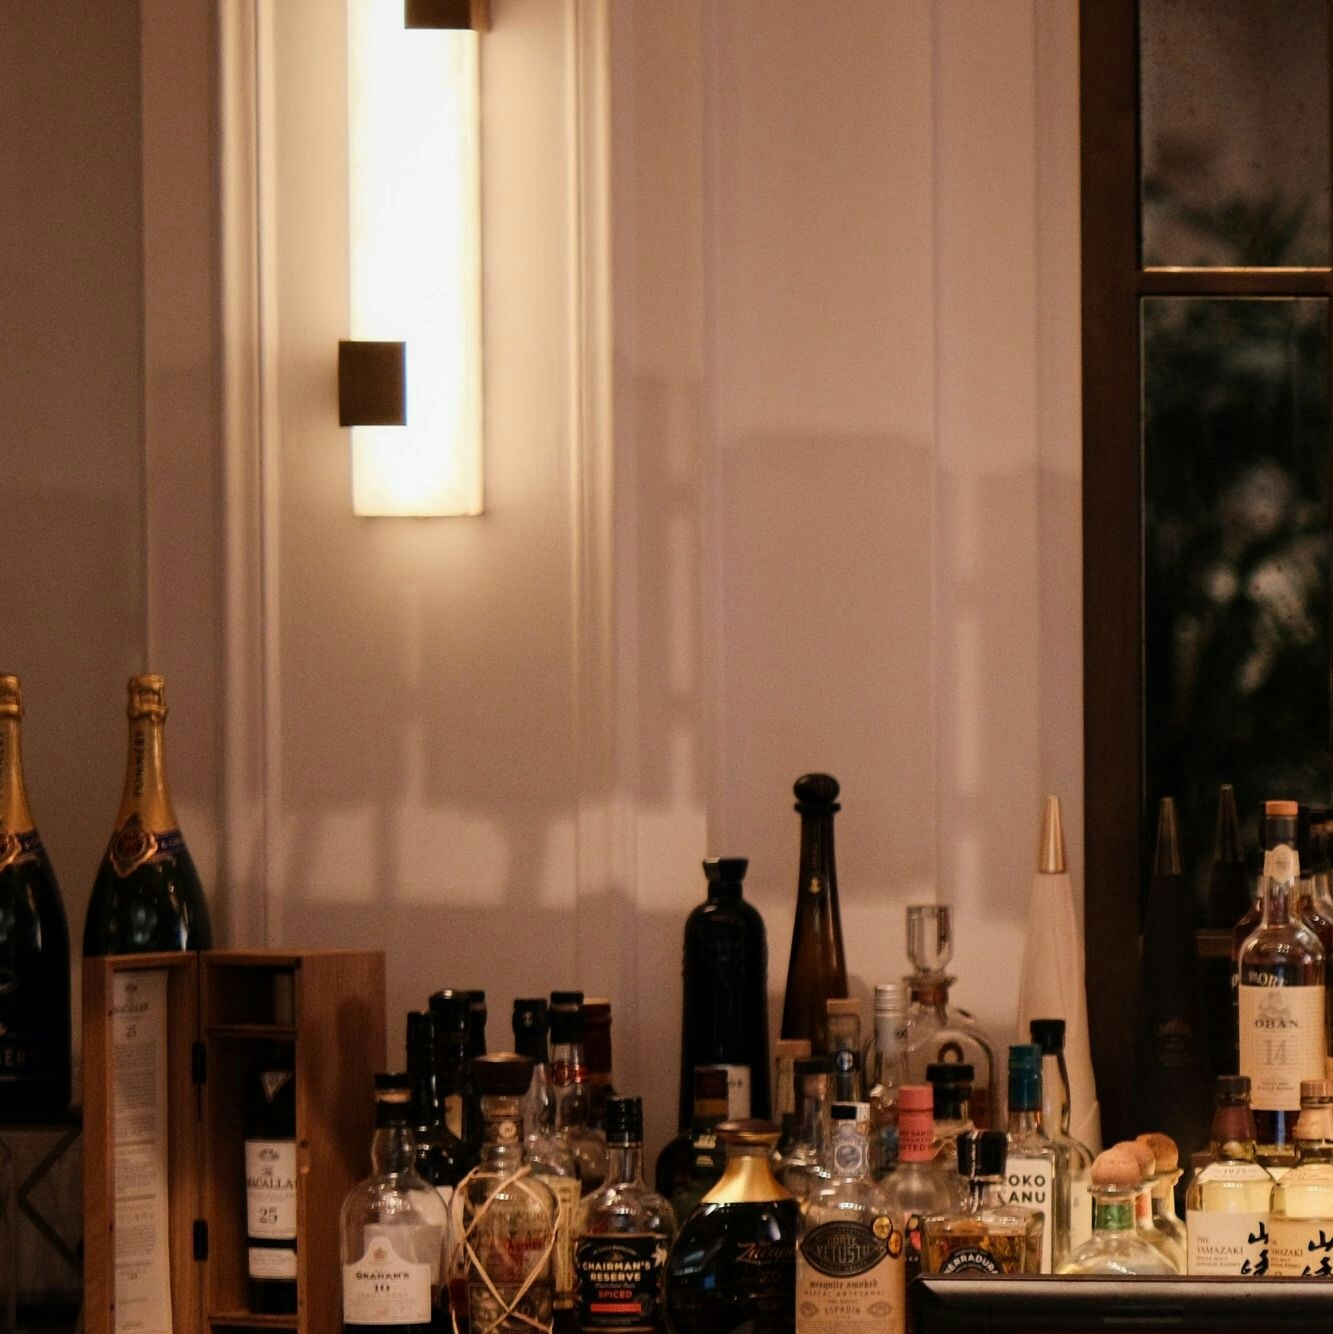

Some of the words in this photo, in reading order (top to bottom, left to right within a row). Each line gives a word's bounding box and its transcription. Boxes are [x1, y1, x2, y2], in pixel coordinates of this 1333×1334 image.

[1254, 1019, 1299, 1029] OBAN
[1263, 1039, 1287, 1066] 14
[1008, 1174, 1046, 1187] OKO
[258, 1207, 279, 1225] 25
[1196, 1246, 1244, 1255] YAMAZAKI
[582, 1261, 651, 1273] CHAIRMAN'S
[590, 1272, 642, 1282] RESERVE
[598, 1290, 633, 1299] SPICED
